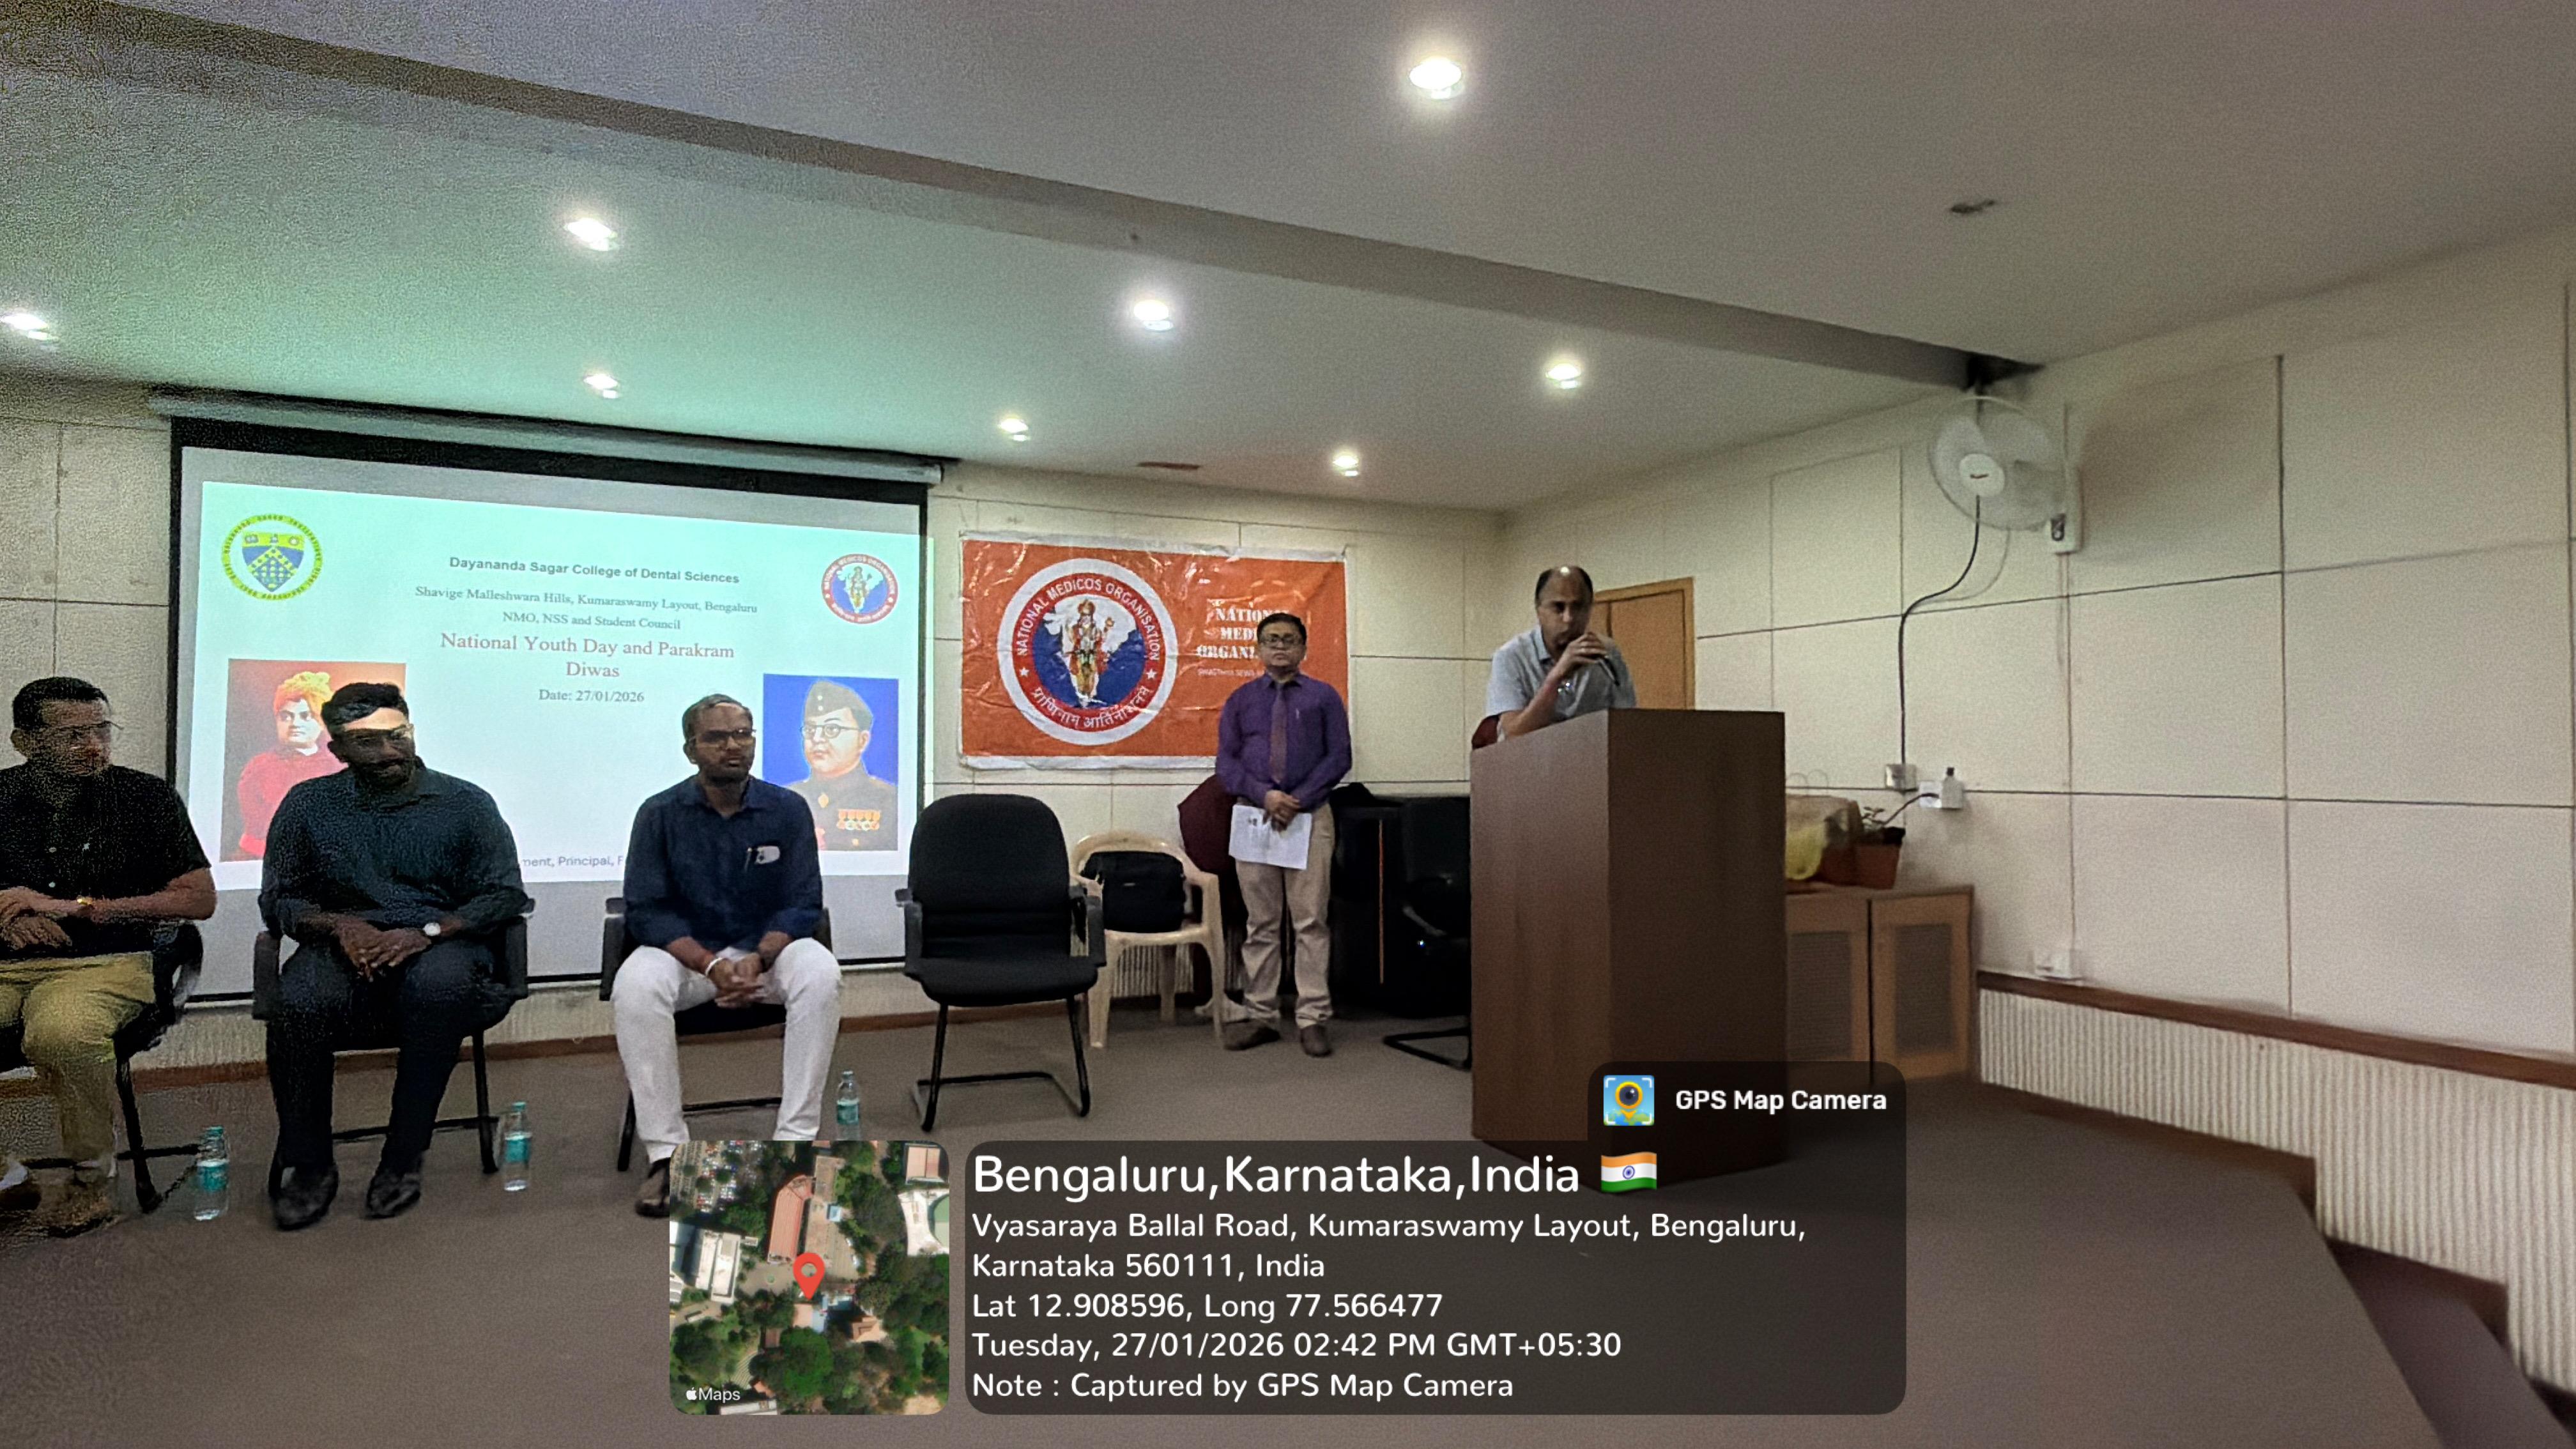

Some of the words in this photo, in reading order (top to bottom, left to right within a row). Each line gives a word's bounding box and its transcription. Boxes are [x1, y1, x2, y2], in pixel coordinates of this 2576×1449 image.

[449, 556, 526, 571] Dayananda
[530, 562, 569, 575] Sagar
[572, 564, 621, 578] College
[625, 568, 638, 578] of
[641, 568, 681, 580] Dental
[684, 571, 740, 583] Sciences
[415, 586, 463, 600] Shavige
[466, 588, 540, 602] Malleshwara
[544, 592, 574, 604] Hills,
[578, 594, 659, 610] Kumaraswamy
[662, 599, 702, 611] Layout,
[705, 601, 757, 613] Bengaluru
[503, 611, 539, 624] NMO,
[542, 613, 569, 624] NSS
[571, 616, 592, 625] and
[594, 616, 636, 627] Student
[639, 618, 681, 629] Council
[1016, 597, 1049, 656] NATIONAL
[1046, 578, 1101, 600] MEDICOS
[1105, 583, 1160, 661] ORGANISATION
[1220, 627, 1257, 641] MEDI
[441, 632, 518, 650] National
[524, 636, 578, 652] Youth
[583, 638, 618, 657] Day
[623, 641, 652, 655] and
[658, 641, 735, 658] Parakram
[566, 661, 620, 677] Diwas
[539, 689, 572, 700] Date:
[575, 690, 645, 702] 27/01/2026
[558, 856, 614, 868] Principal,
